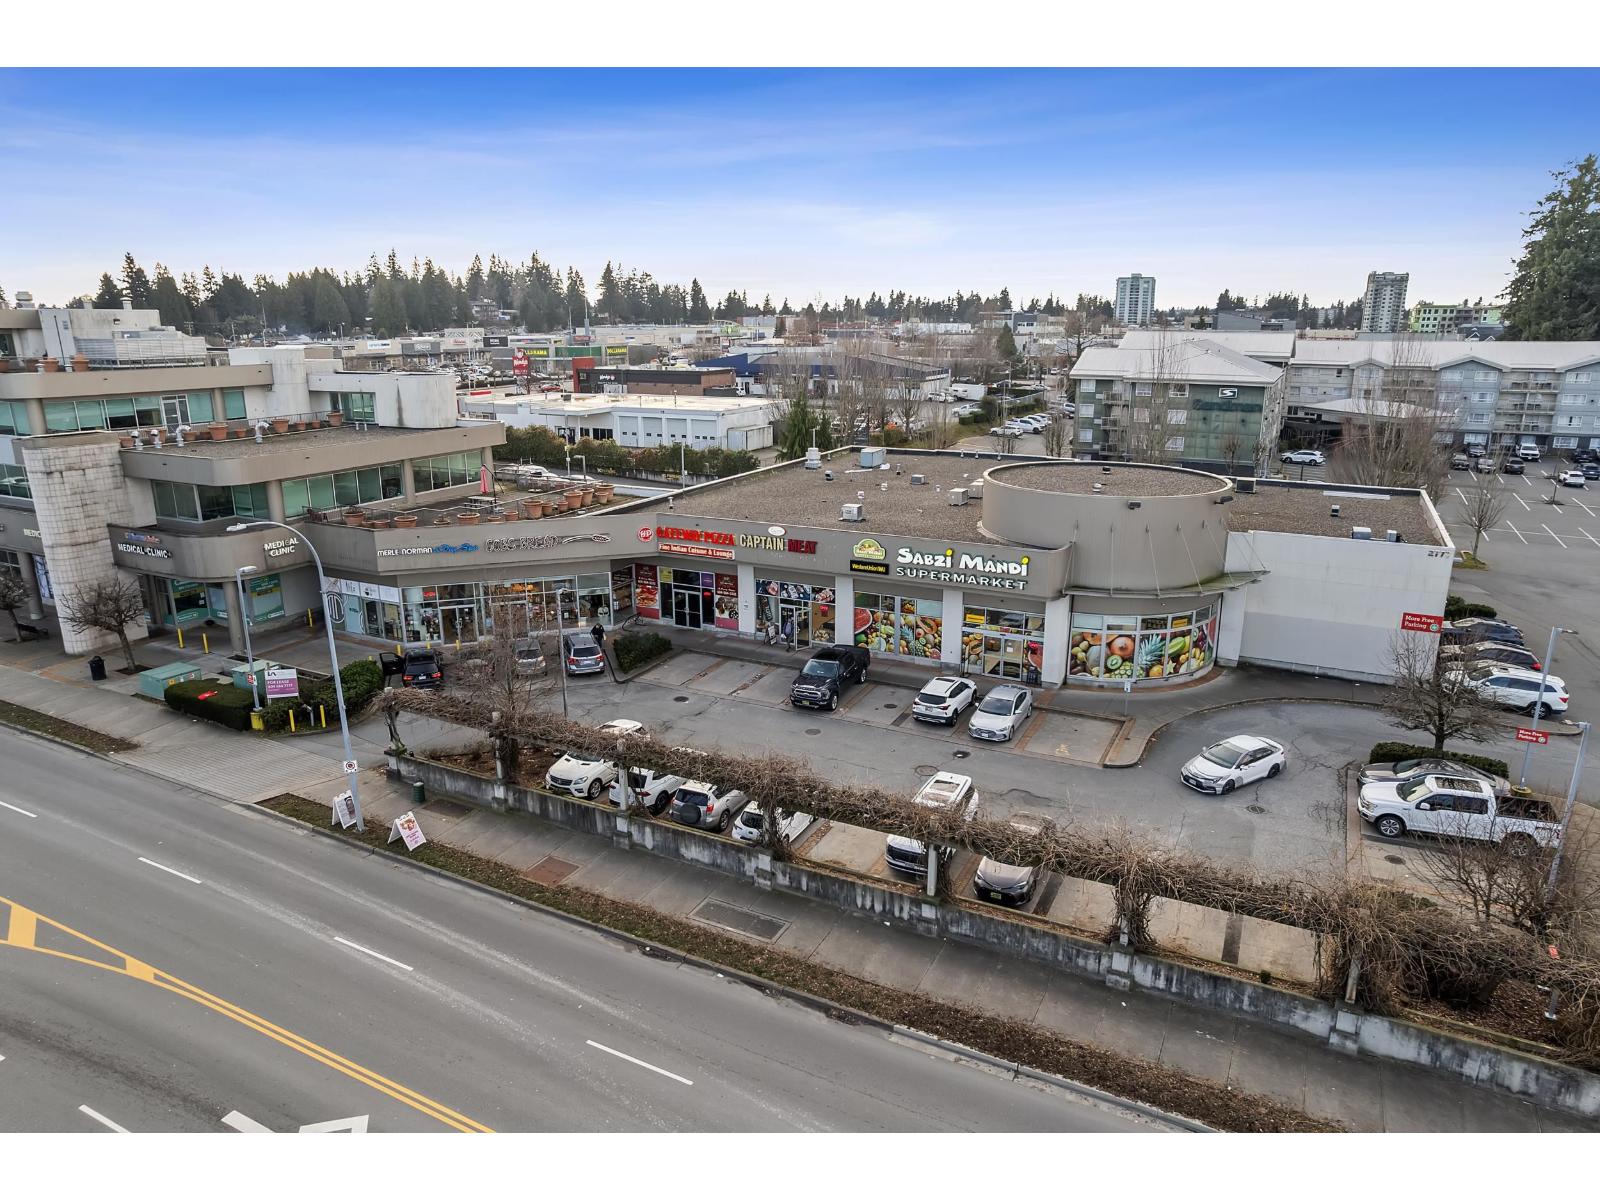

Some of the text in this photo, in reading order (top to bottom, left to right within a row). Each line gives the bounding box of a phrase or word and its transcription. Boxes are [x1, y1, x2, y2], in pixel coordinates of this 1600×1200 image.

[263, 537, 299, 550] MEDICAL
[740, 534, 785, 551] CAPTAIN
[117, 543, 168, 558] MEDICAL CLINIC
[270, 546, 296, 557] CLINIC
[377, 549, 399, 557] MERLE
[402, 547, 432, 555] NORMAN
[896, 567, 1028, 591] SUPERMARKET
[1404, 621, 1427, 629] Parking
